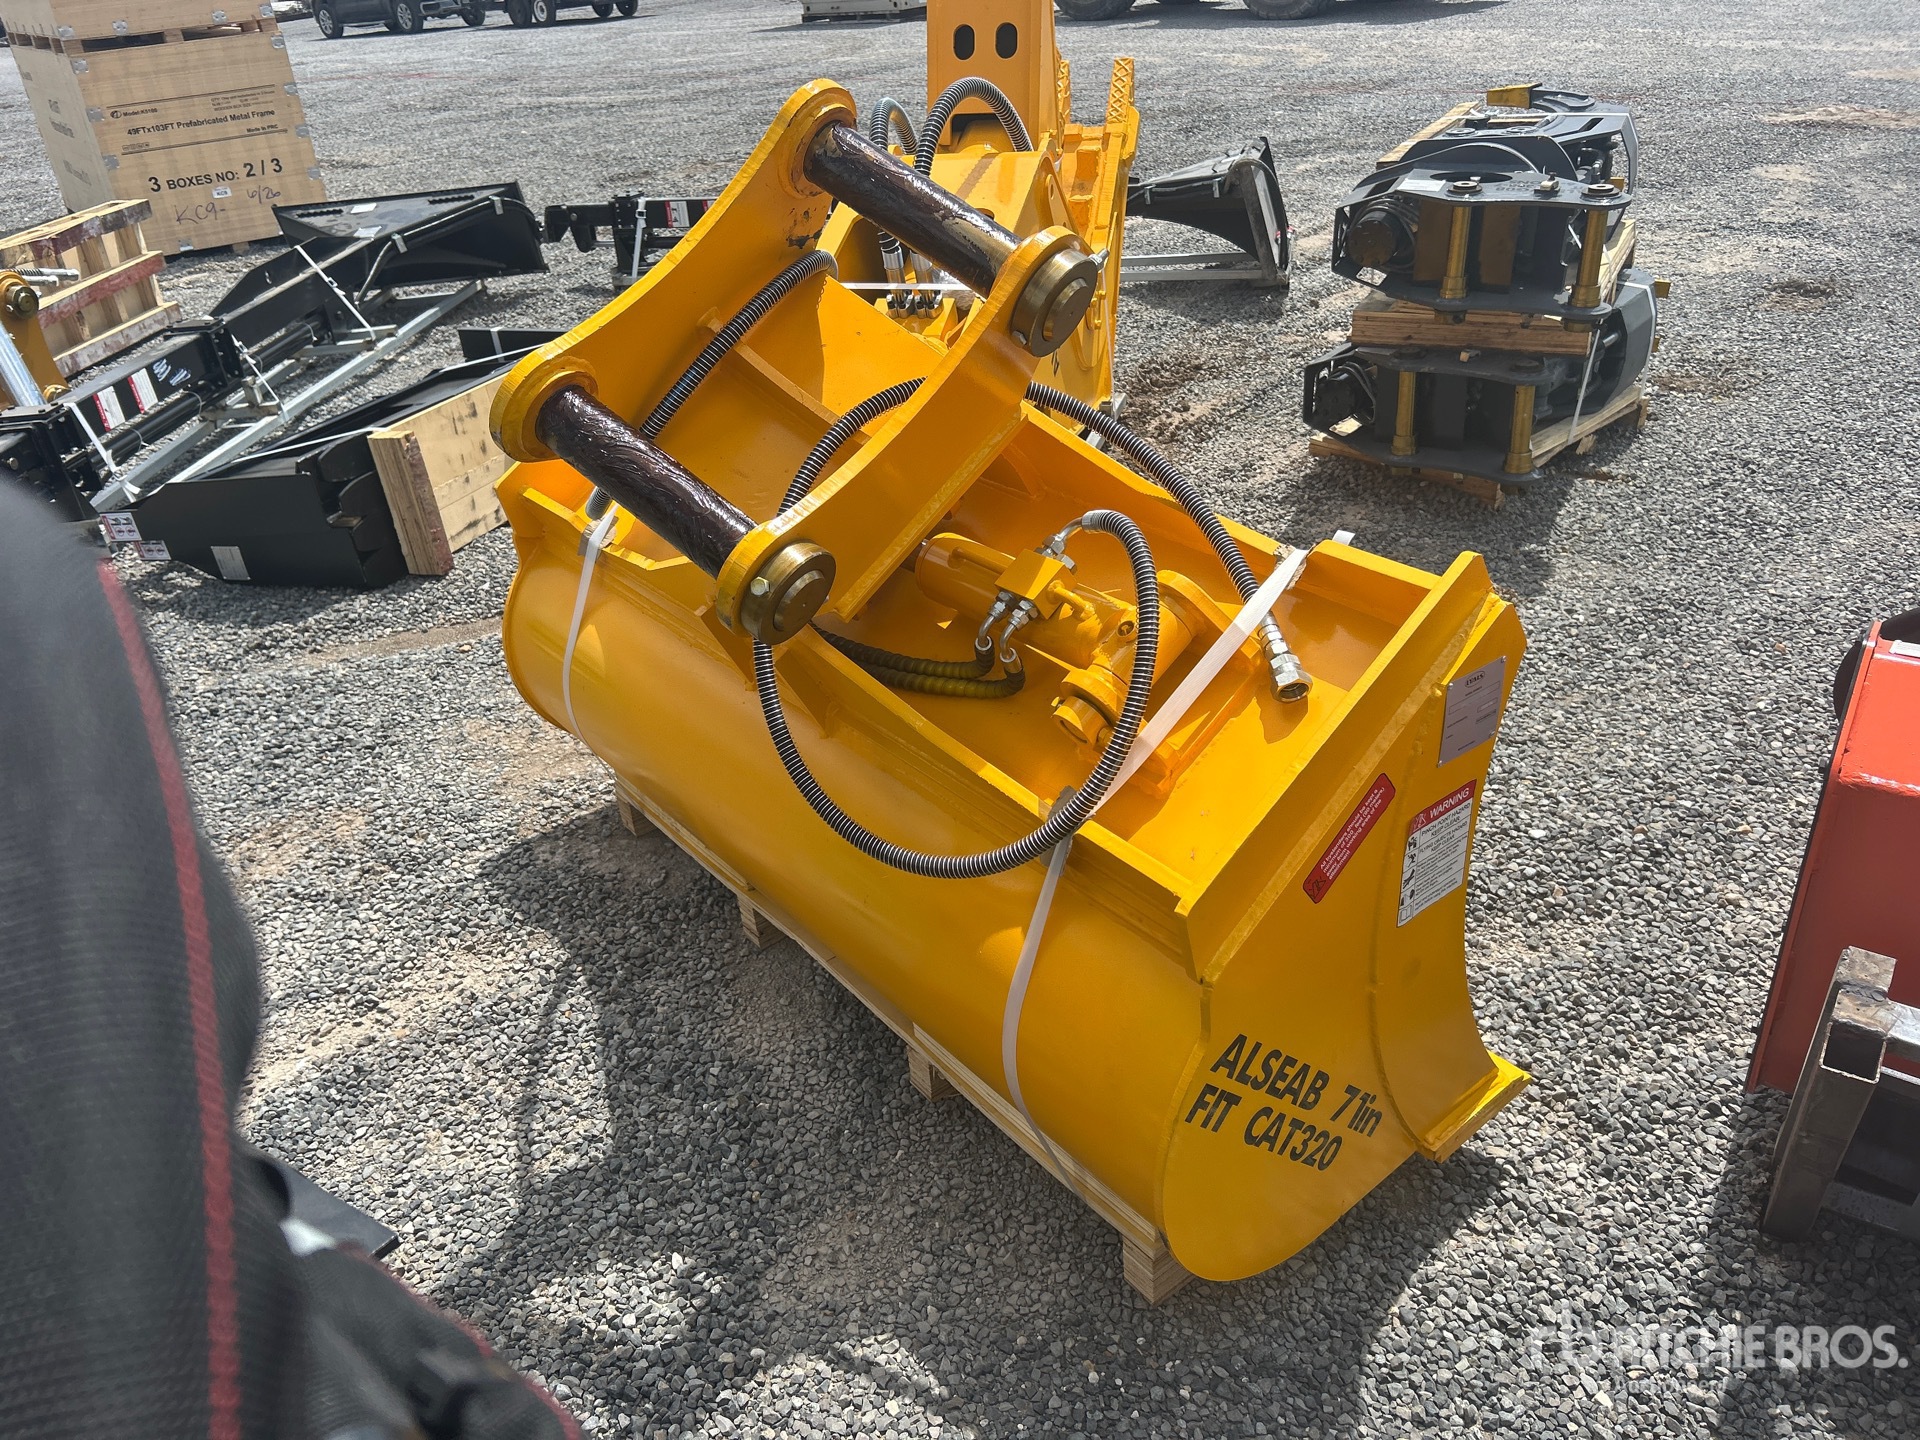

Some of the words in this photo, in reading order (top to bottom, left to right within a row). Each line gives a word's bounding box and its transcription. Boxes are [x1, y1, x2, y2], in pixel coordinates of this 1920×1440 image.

[127, 122, 174, 136] 49FTx103FT
[176, 116, 228, 128] Prefabricated
[230, 112, 250, 122] Metal
[252, 109, 276, 118] Frame
[148, 176, 162, 192] 3
[166, 174, 213, 190] BOXES
[216, 170, 240, 184] NO:
[243, 162, 257, 178] 2
[271, 158, 283, 174] 3
[1346, 813, 1360, 832] should
[1360, 806, 1366, 814] be
[1365, 794, 1374, 806] kept
[1430, 788, 1470, 818] WARNING
[1346, 828, 1362, 848] working
[1362, 814, 1371, 828] area
[1422, 822, 1437, 836] PINCH
[1437, 814, 1452, 826] POINT
[1430, 826, 1444, 838] KEEP
[1444, 816, 1460, 828] CLEAR
[1323, 848, 1340, 873] minimum
[1354, 816, 1364, 828] feet
[1210, 1033, 1330, 1111] ALSEAB
[1330, 1084, 1383, 1138] 71in
[1184, 1082, 1242, 1133] FIT
[1244, 1106, 1343, 1171] CAT320
